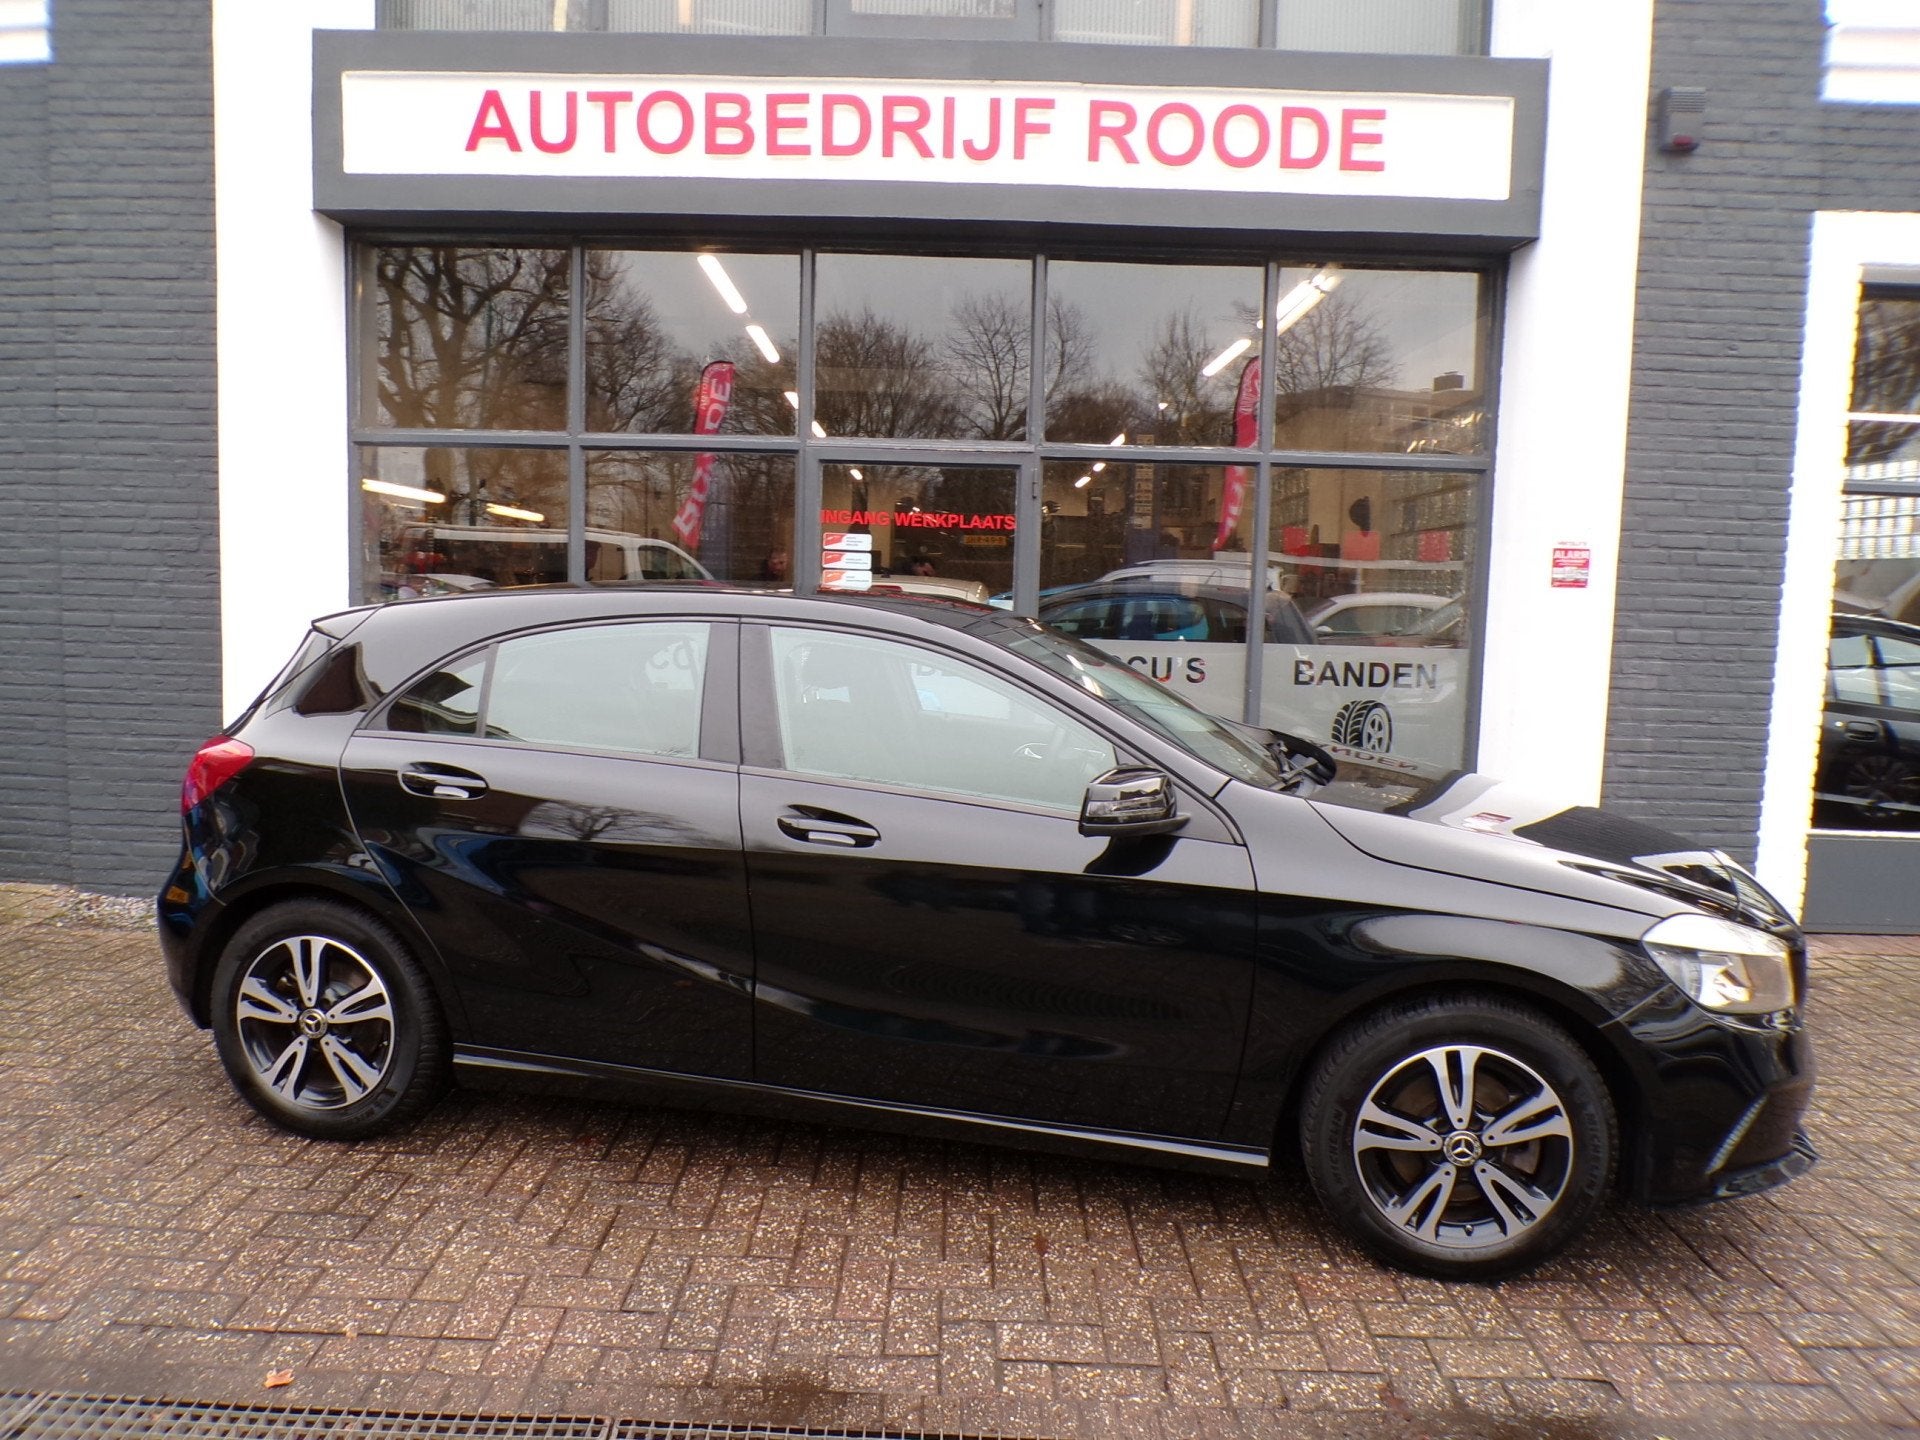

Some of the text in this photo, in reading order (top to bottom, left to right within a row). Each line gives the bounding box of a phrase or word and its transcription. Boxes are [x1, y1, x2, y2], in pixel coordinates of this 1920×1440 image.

[464, 89, 1387, 172] AUTOBEDRIJF ROODE
[820, 509, 1016, 530] INGANG WERKPLAATS
[1294, 659, 1438, 690] BANDEN
